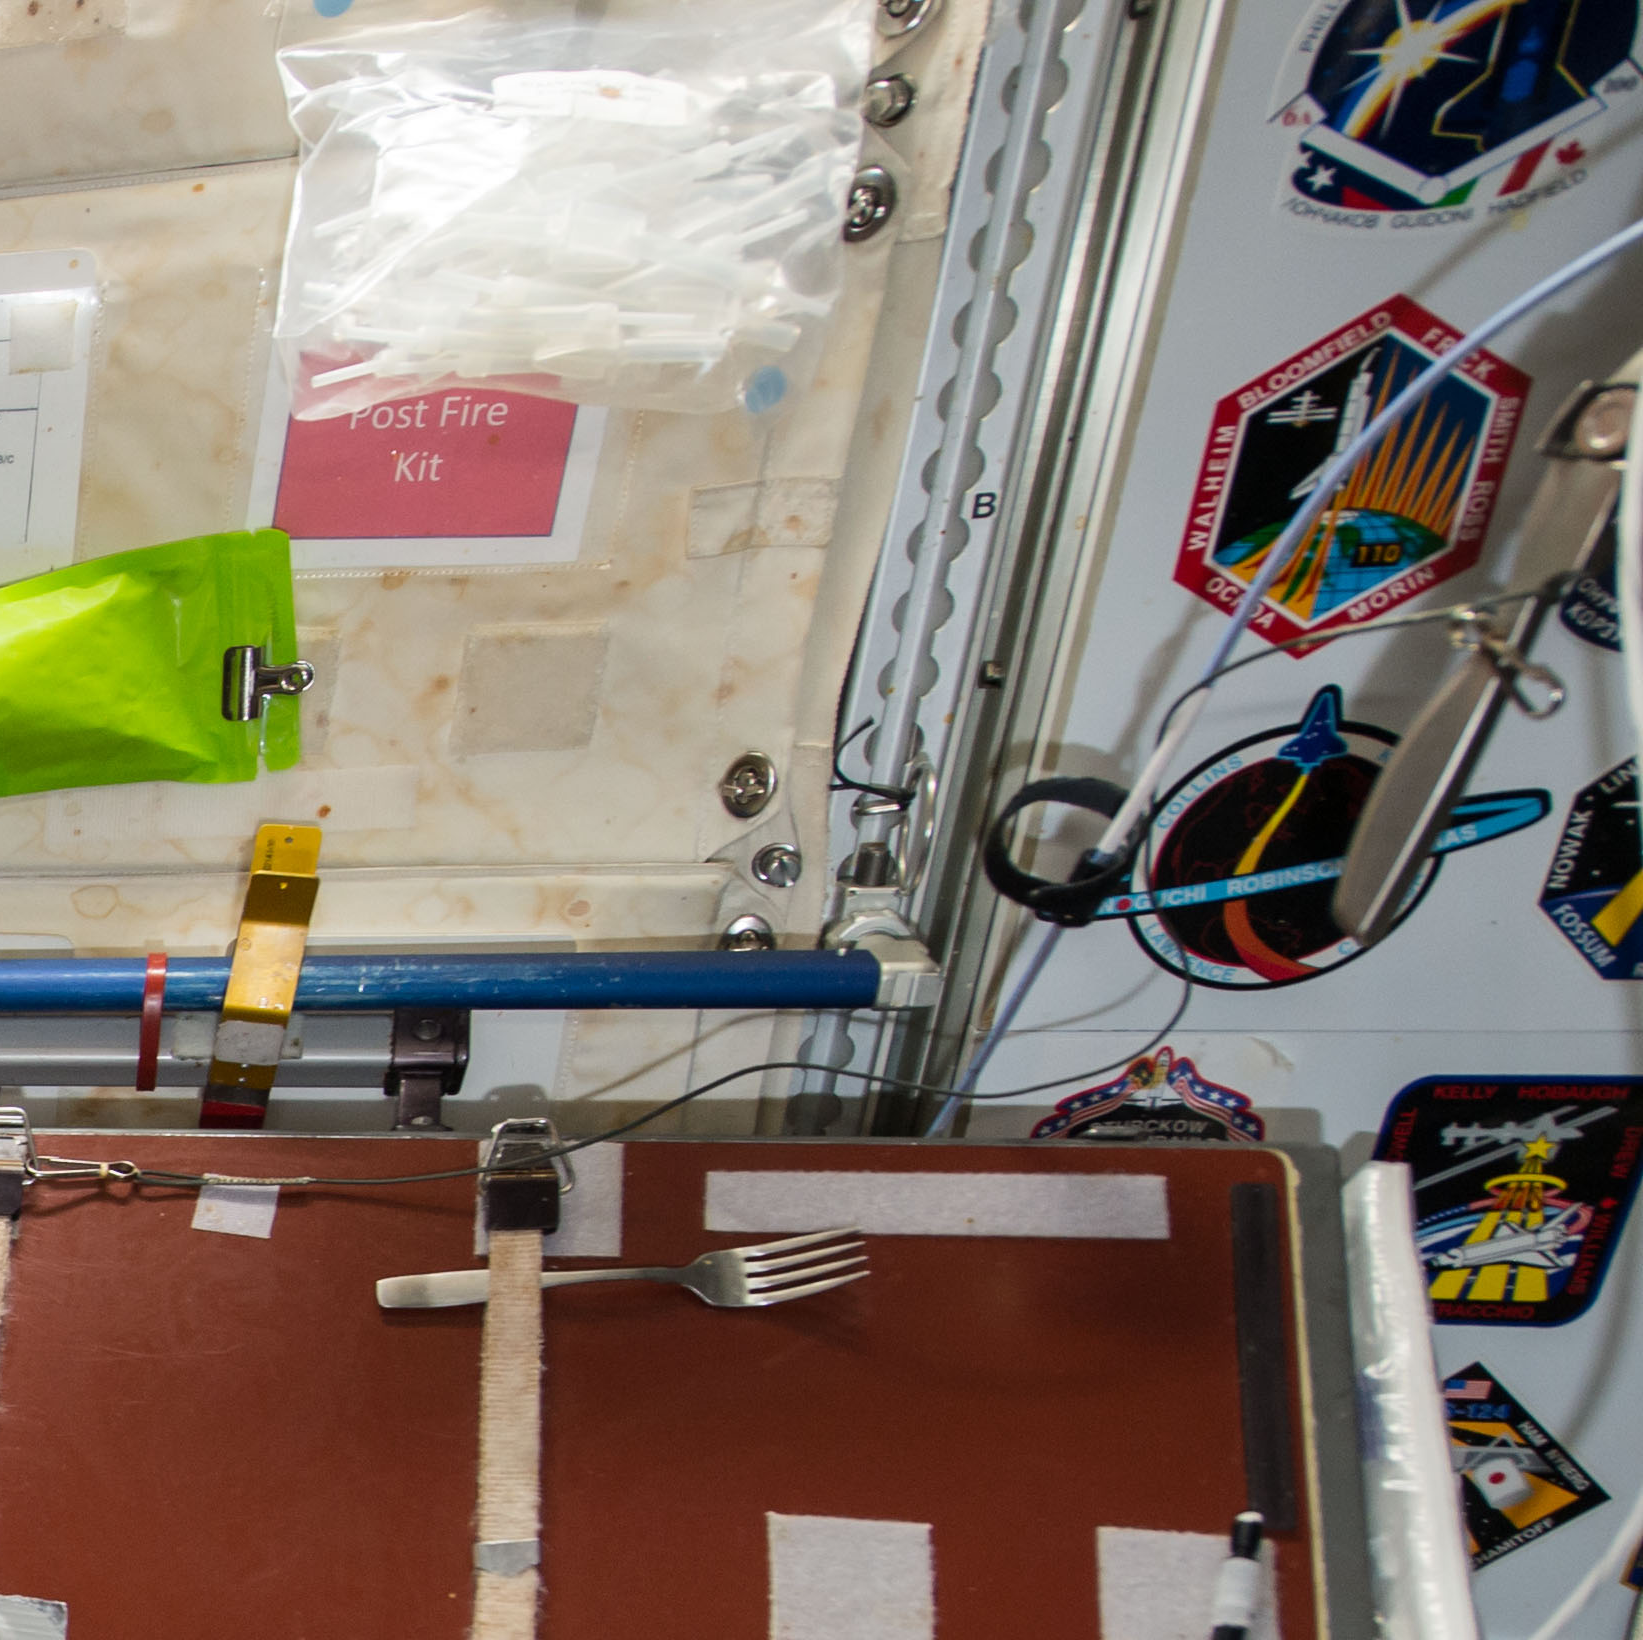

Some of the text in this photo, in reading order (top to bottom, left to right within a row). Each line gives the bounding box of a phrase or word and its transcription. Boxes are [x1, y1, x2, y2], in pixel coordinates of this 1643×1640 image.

[1236, 309, 1497, 410] BLOOMFIELD FRCK
[348, 395, 510, 432] Post Fire
[393, 452, 445, 484] Kit
[1187, 424, 1238, 551] WALHEIM
[1459, 395, 1521, 542] SMITH ROSS
[972, 490, 997, 521] B
[1356, 543, 1403, 565] 110
[1348, 566, 1437, 623] MORIN
[1155, 753, 1246, 831] COLLINS
[1547, 808, 1593, 891] NOWAK
[1551, 901, 1618, 970] FOSSUM
[1432, 1084, 1632, 1100] KELLY HOBAUGH
[1567, 1212, 1613, 1295] WILLIAMS
[1516, 1419, 1549, 1448] HAM
[1472, 1516, 1556, 1567] HAMITOFF
